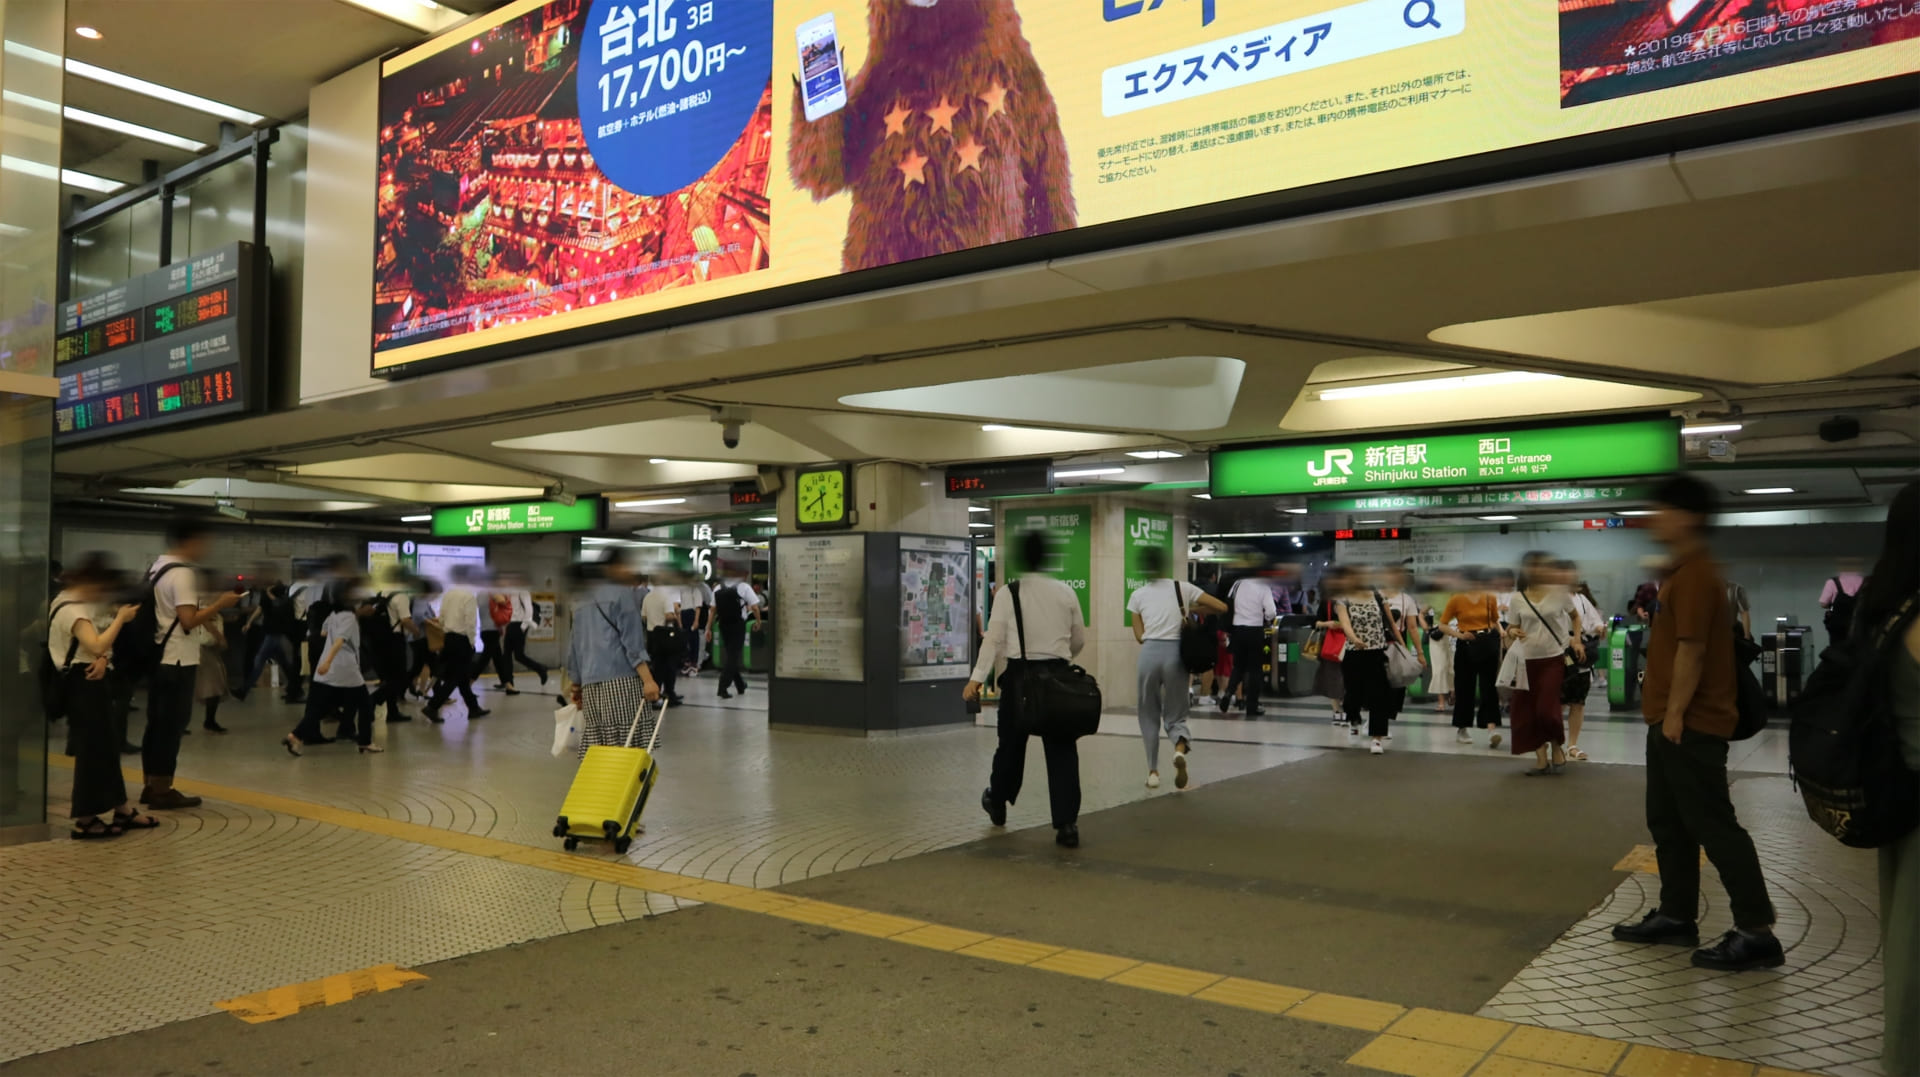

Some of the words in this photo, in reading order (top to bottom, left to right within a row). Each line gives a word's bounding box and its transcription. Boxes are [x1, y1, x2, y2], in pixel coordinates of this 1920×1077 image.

[686, 1, 713, 30] 3日
[600, 0, 677, 65] 台北
[1124, 22, 1333, 99] エクスペディア
[1365, 443, 1427, 468] 新宿駅
[1479, 438, 1511, 455] 西口
[1307, 448, 1354, 478] JR
[1479, 456, 1504, 466] West
[1507, 454, 1552, 465] Entrance
[1365, 468, 1418, 484] Shinjuku
[1422, 466, 1467, 480] Station
[466, 509, 484, 527] JR
[1130, 517, 1150, 539] JR
